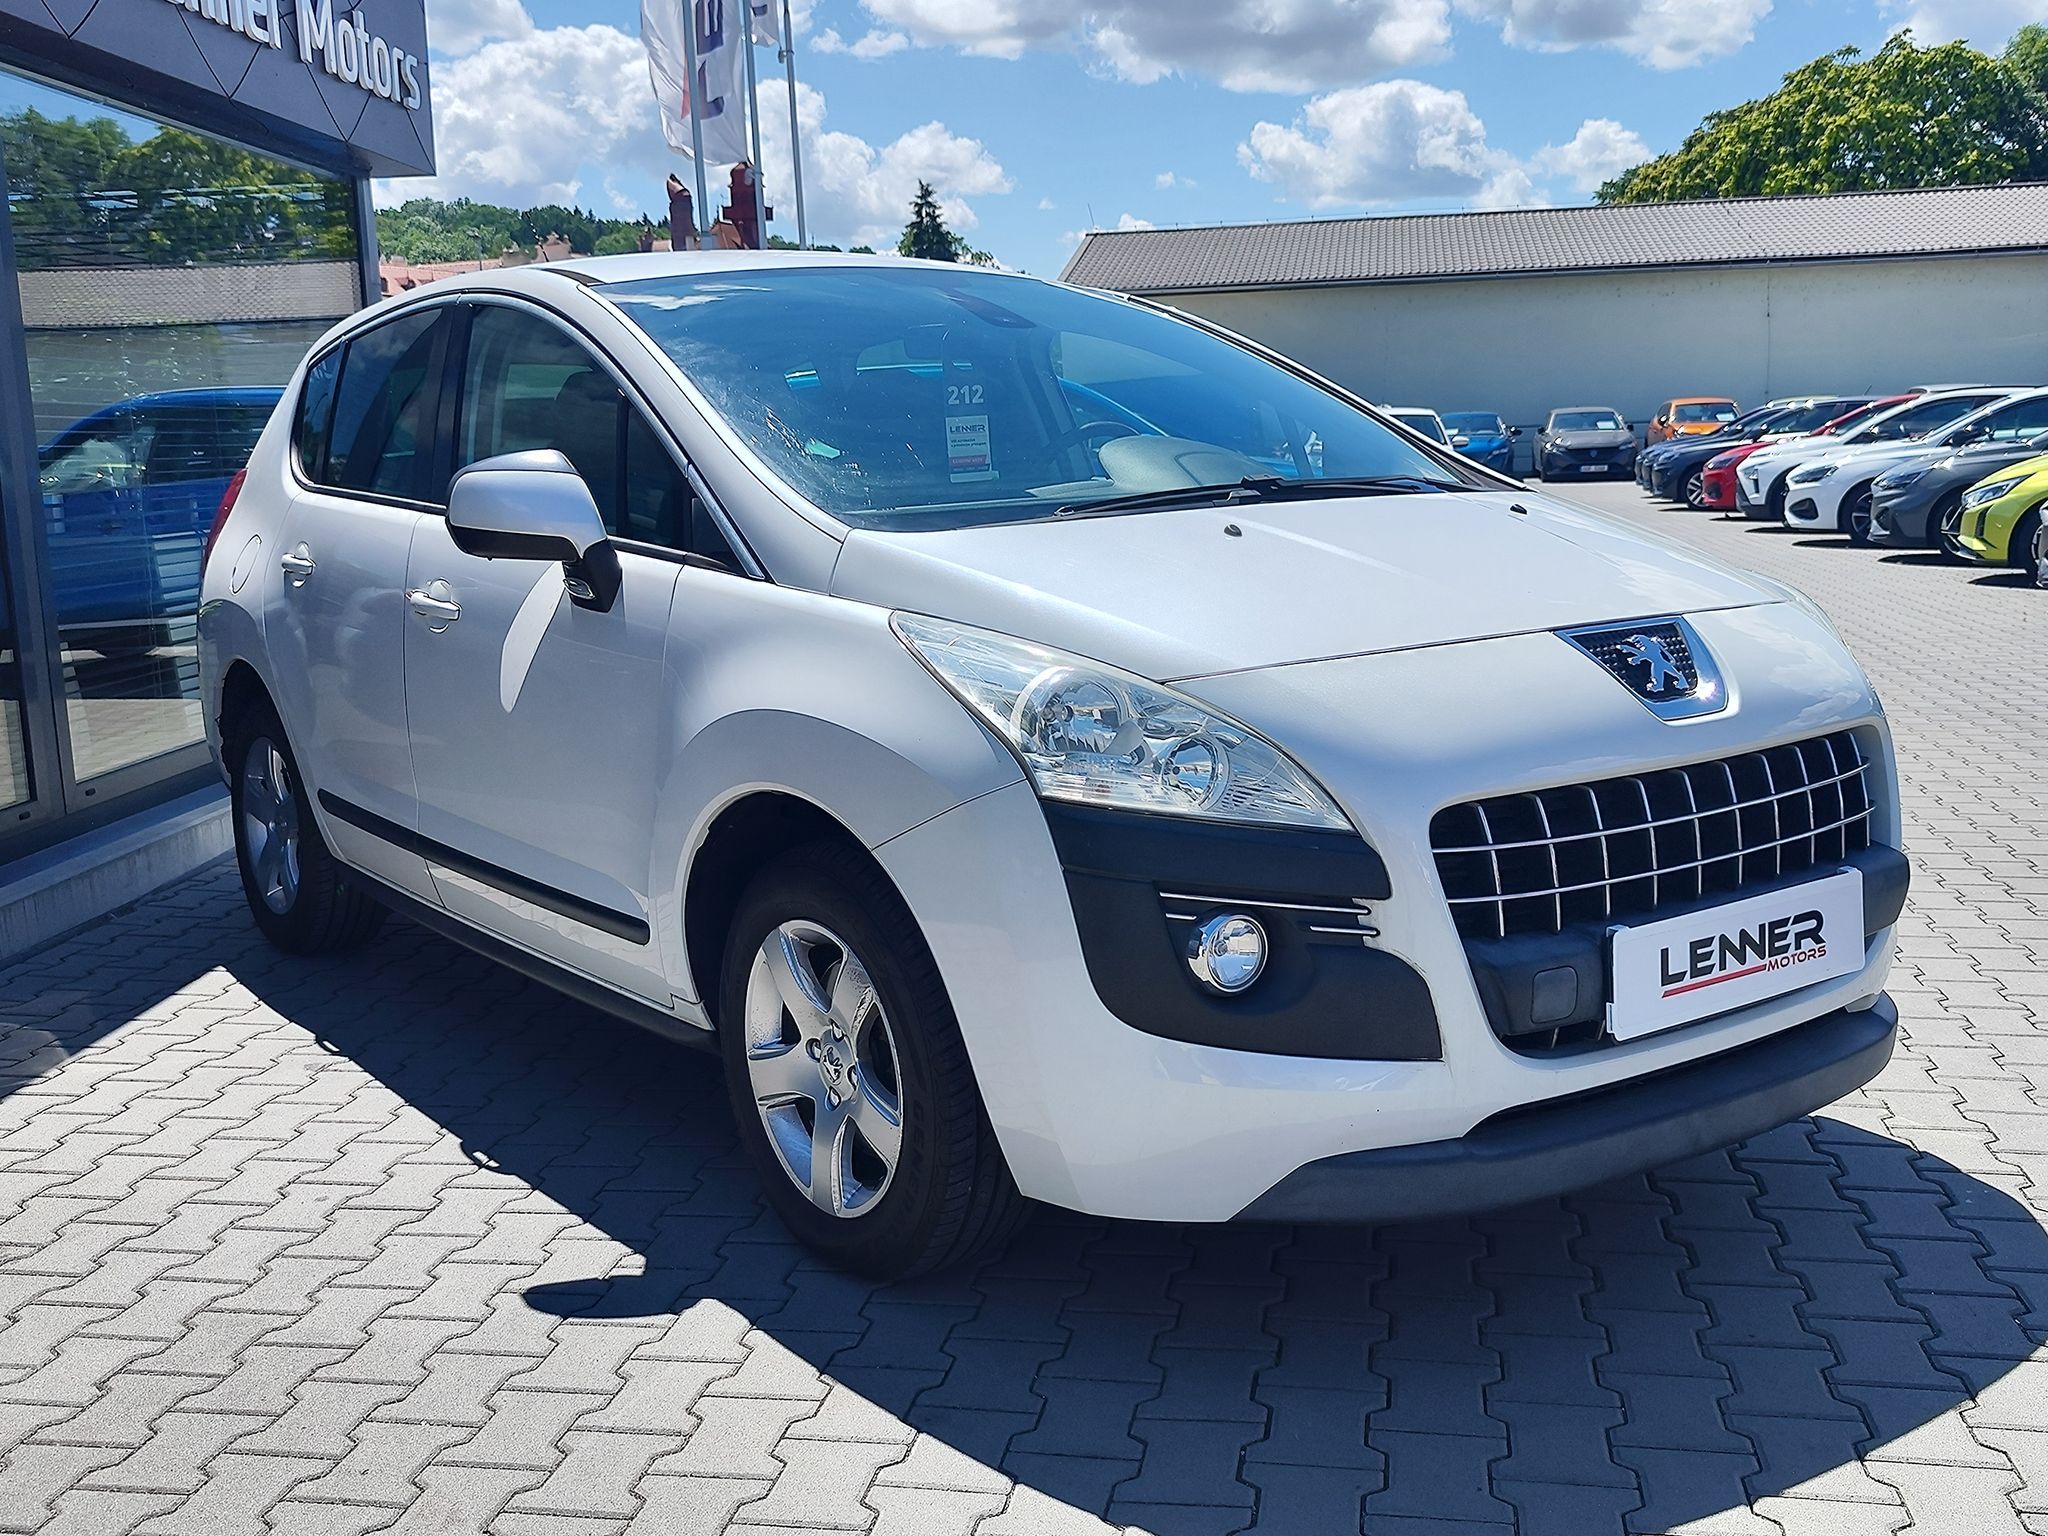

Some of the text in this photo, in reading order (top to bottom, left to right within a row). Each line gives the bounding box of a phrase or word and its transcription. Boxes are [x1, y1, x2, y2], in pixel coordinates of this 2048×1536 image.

[297, 0, 421, 110] Motors
[947, 384, 984, 405] 212
[949, 424, 986, 434] LENNER
[1660, 909, 1826, 987] LENNER
[1766, 944, 1827, 972] MOTORS
